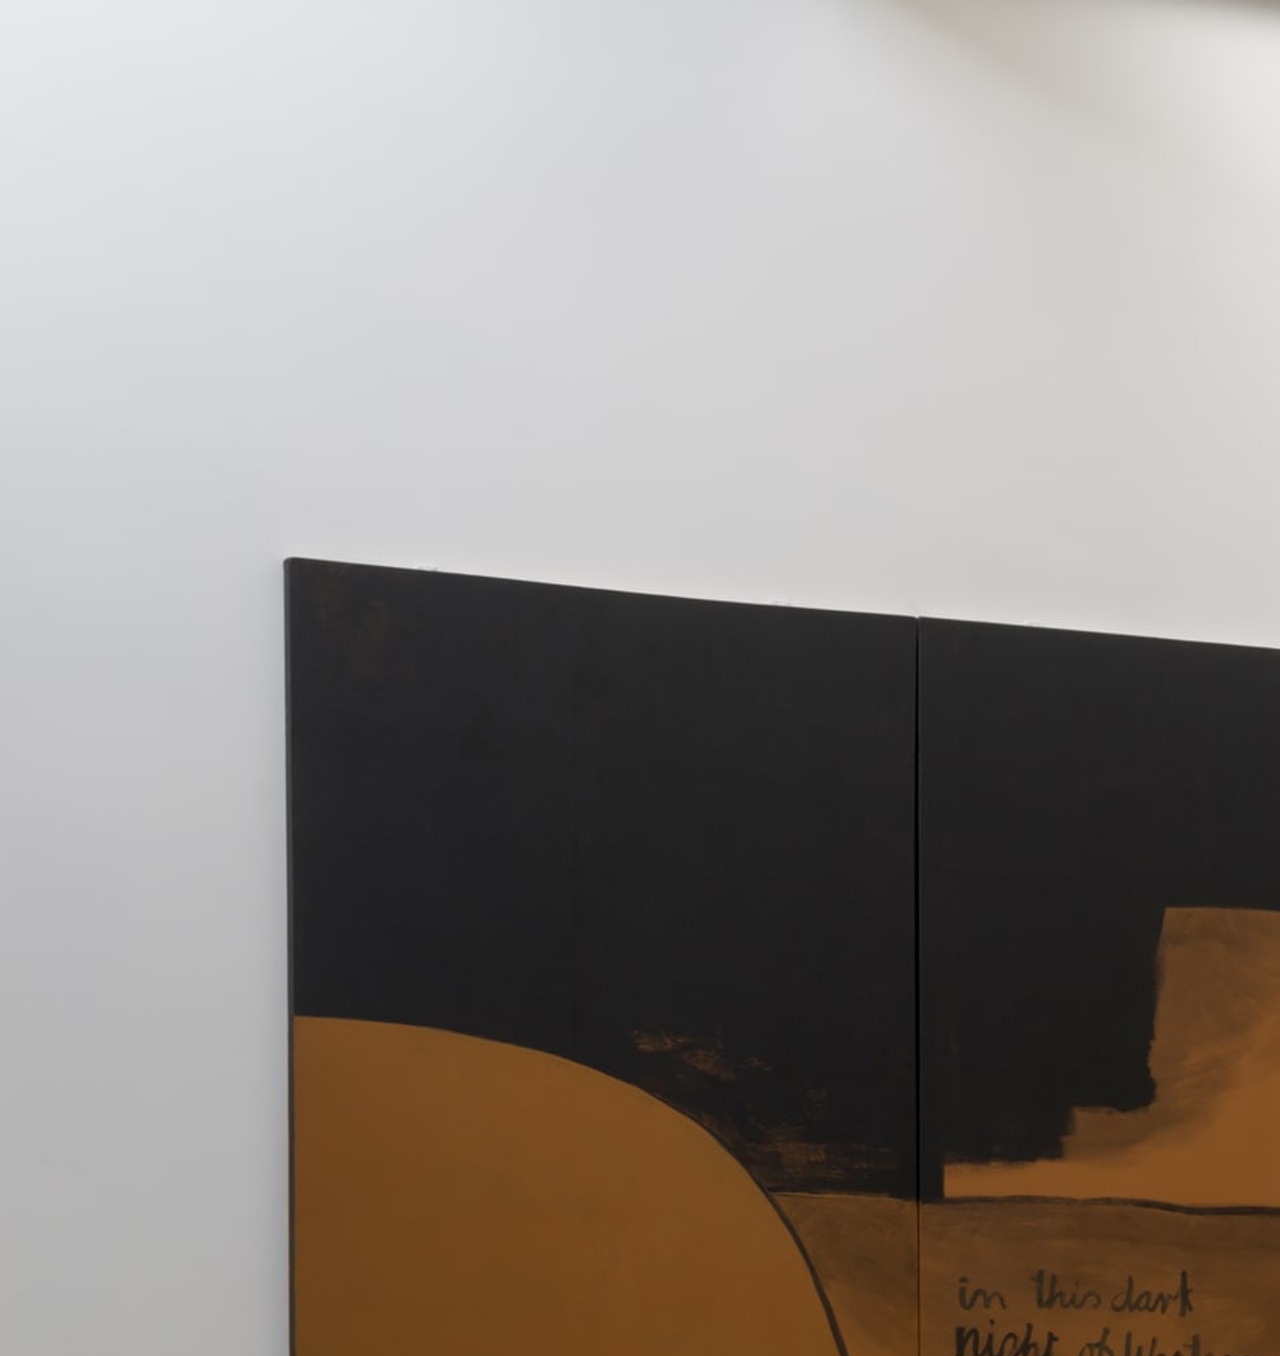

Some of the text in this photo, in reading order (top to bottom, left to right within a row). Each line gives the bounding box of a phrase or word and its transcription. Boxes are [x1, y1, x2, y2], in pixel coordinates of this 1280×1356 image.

[958, 1269, 1194, 1317] in this dark
